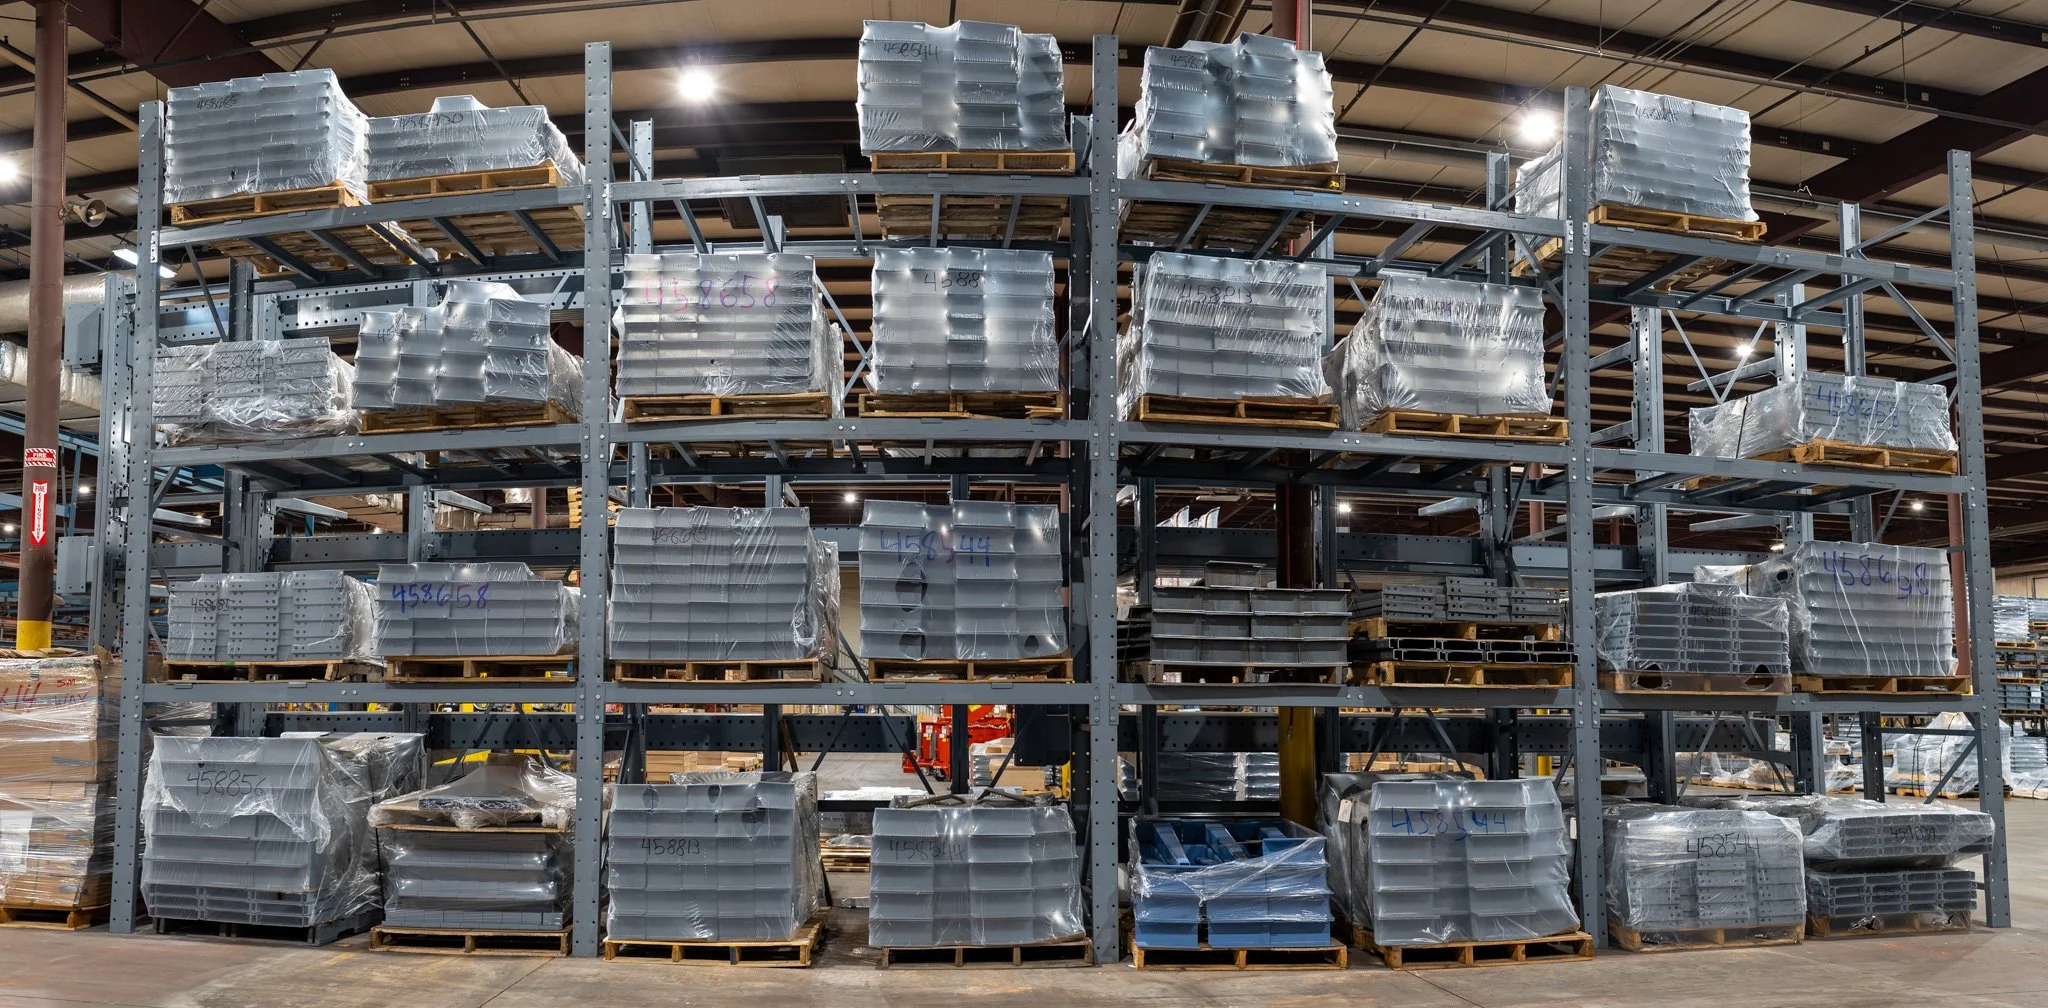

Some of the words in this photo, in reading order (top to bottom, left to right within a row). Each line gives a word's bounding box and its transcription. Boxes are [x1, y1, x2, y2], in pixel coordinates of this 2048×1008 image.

[645, 273, 781, 314] 458658
[880, 530, 991, 567] 458544
[1823, 551, 1929, 600] 458658
[392, 583, 489, 614] 458658
[187, 769, 266, 796] 458856
[1391, 806, 1507, 842] 458544
[641, 838, 700, 857] 458813
[889, 839, 965, 866] 458544
[1687, 832, 1761, 860] 458544
